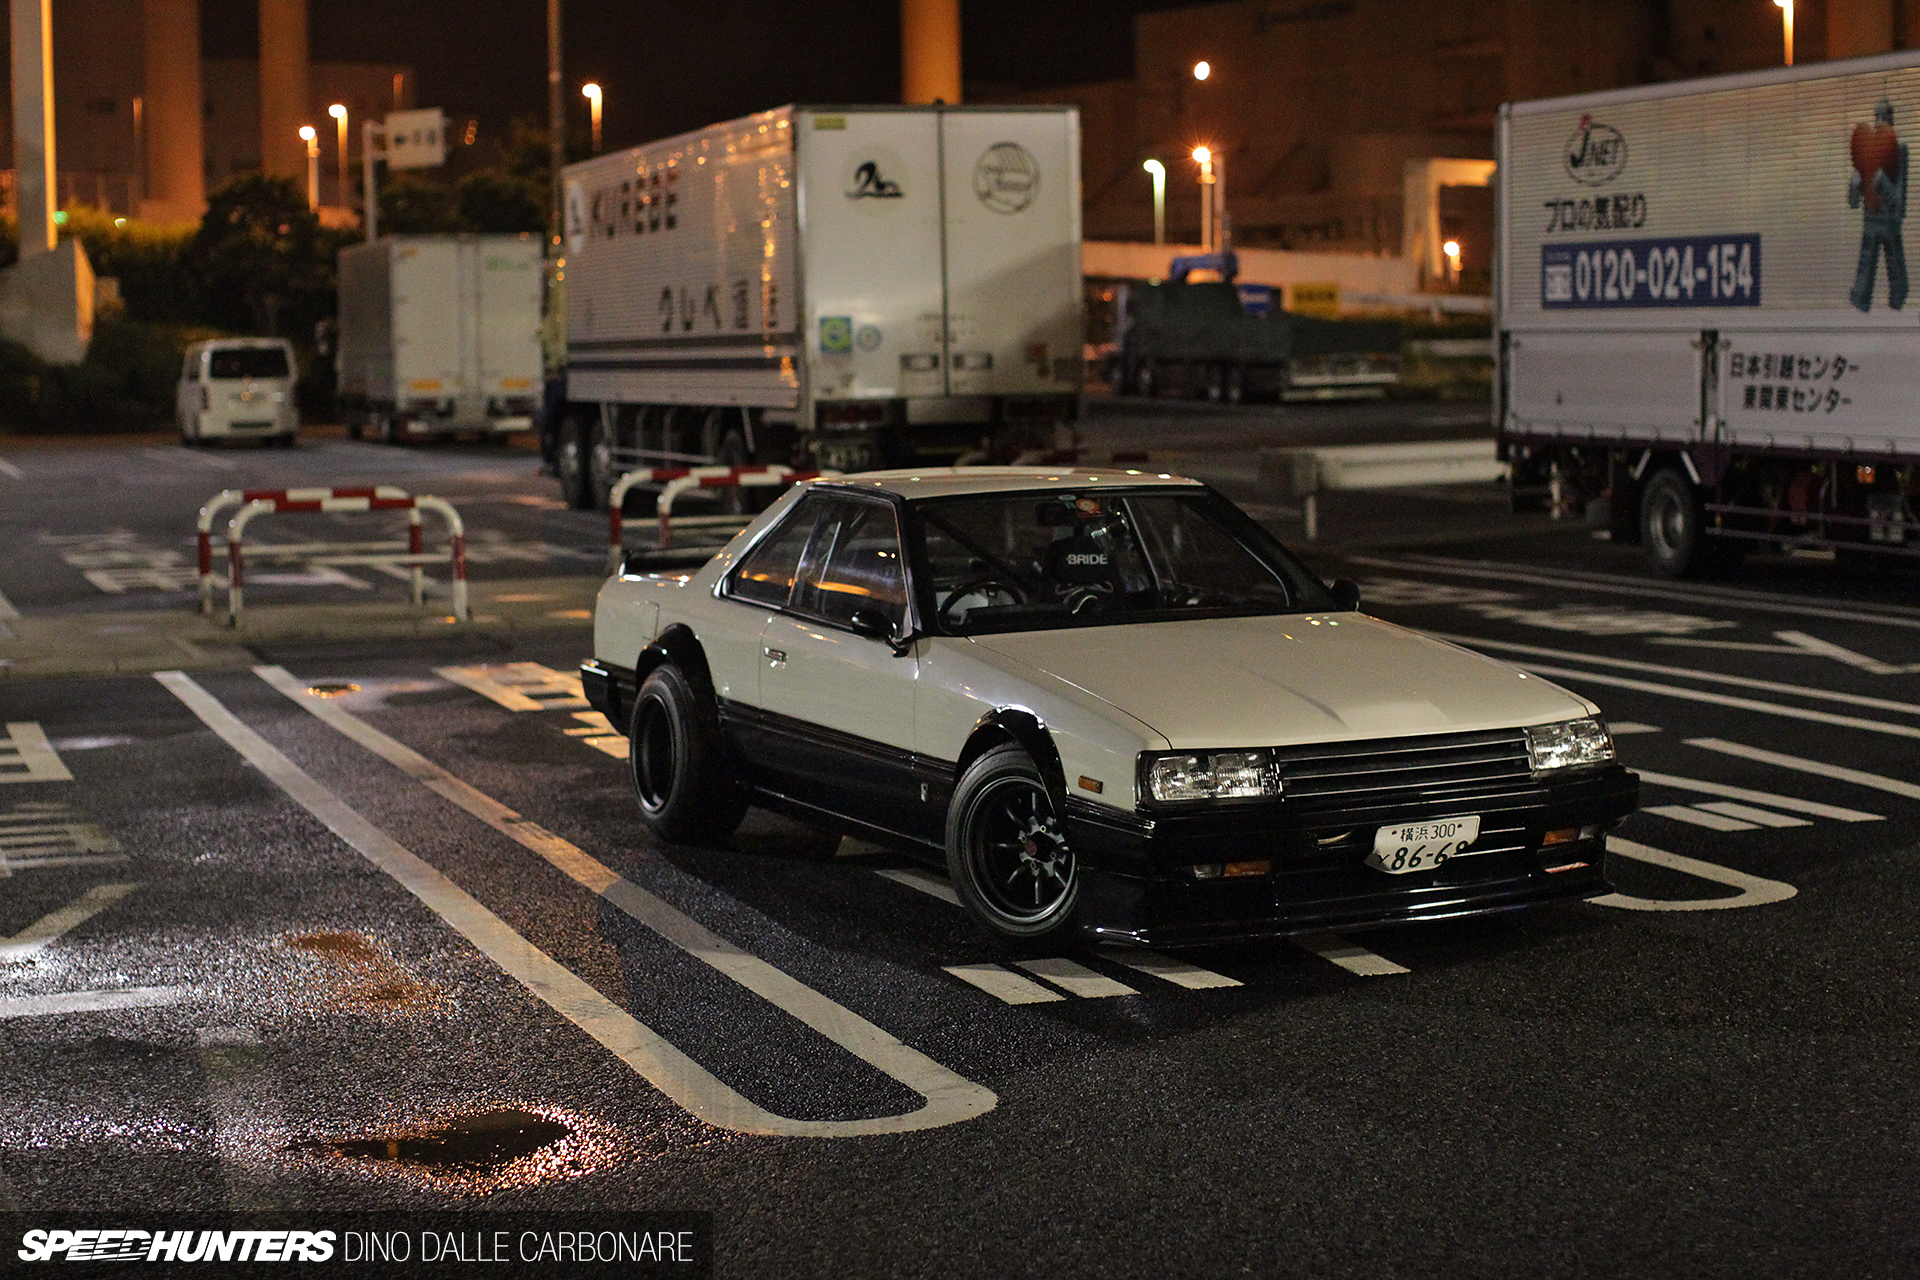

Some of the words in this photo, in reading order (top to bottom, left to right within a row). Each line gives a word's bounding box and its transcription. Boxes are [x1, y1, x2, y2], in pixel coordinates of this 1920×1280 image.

[1575, 243, 1753, 300] 0120-024-154
[1730, 352, 1860, 380] 日本引越センター
[1066, 553, 1109, 566] BRIDE
